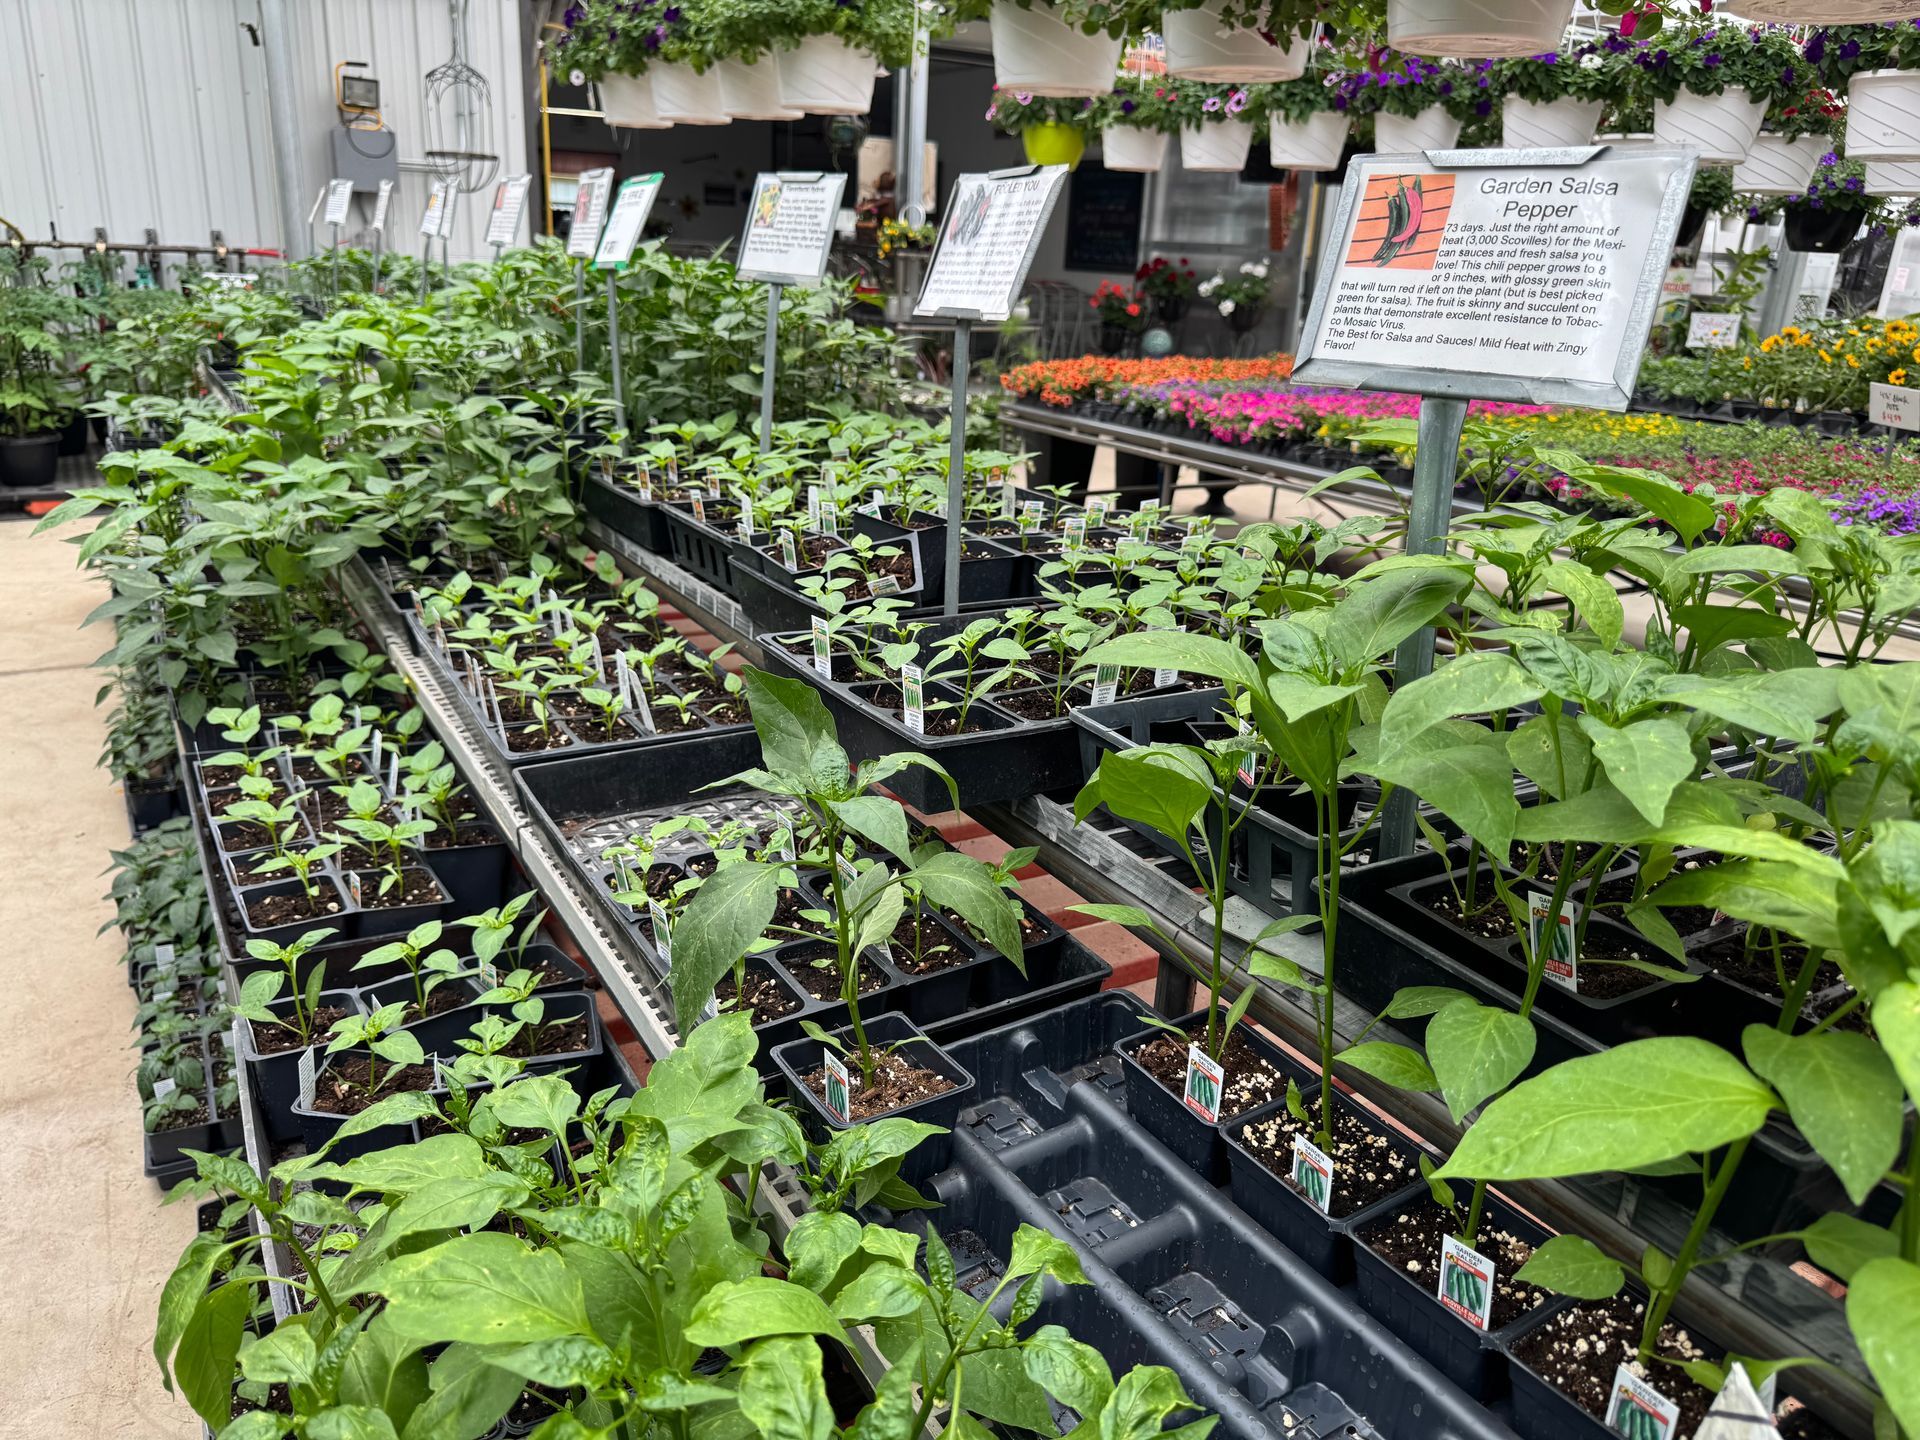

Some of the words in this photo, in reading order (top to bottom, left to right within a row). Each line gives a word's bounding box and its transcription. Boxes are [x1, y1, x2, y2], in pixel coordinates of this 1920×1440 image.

[1024, 180, 1040, 192] YOU
[1480, 177, 1552, 195] Garden
[1559, 177, 1619, 196] Salsa
[1503, 200, 1577, 221] Pepper
[1446, 223, 1459, 233] 73
[1460, 223, 1486, 234] days.
[1489, 223, 1511, 232] Just
[1514, 223, 1531, 233] the
[1533, 223, 1558, 236] right
[1561, 226, 1604, 236] amount
[1607, 226, 1620, 237] of
[1442, 236, 1464, 245] heat
[1465, 235, 1498, 246] (3,000
[1500, 235, 1552, 248] Scovilles)
[1555, 236, 1570, 246] for
[1573, 237, 1590, 247] the
[1593, 239, 1627, 250] Mexi-
[1497, 248, 1518, 258] and
[1519, 248, 1547, 259] fresh
[1549, 249, 1578, 260] salsa
[1581, 252, 1603, 262] you
[1434, 260, 1459, 270] love!
[1462, 260, 1481, 270] This
[1484, 261, 1505, 270] chili
[1507, 263, 1544, 272] pepper
[1547, 264, 1581, 274] grows
[1583, 263, 1595, 273] to
[1599, 265, 1607, 275] 8
[1431, 274, 1442, 282] or
[1444, 272, 1450, 282] 9
[1452, 273, 1487, 283] inches,
[1491, 274, 1512, 284] with
[1514, 275, 1549, 287] glossy
[1551, 277, 1583, 288] green
[1587, 278, 1611, 289] skin
[1340, 281, 1358, 290] that
[1360, 282, 1375, 291] will
[1377, 283, 1396, 293] turn
[1398, 284, 1415, 294] red
[1417, 284, 1425, 294] if
[1425, 285, 1440, 295] left
[1442, 286, 1454, 295] on
[1457, 286, 1473, 295] the
[1474, 286, 1501, 297] plant
[1503, 287, 1525, 299] (but
[1527, 288, 1536, 298] is
[1540, 289, 1563, 299] best
[1565, 291, 1603, 302] picked
[1336, 294, 1363, 303] green
[1366, 294, 1379, 303] for
[1381, 296, 1412, 307] salsa).
[1416, 296, 1433, 306] The
[1436, 297, 1455, 307] fruit
[1457, 298, 1465, 307] is
[1468, 298, 1501, 310] skinny
[1504, 301, 1524, 311] and
[1527, 302, 1578, 314] succulent
[1581, 305, 1596, 314] on
[1330, 317, 1341, 325] co
[1343, 317, 1377, 328] Mosaic
[1380, 319, 1406, 330] Virus.
[1333, 306, 1361, 315] plants
[1363, 306, 1382, 316] that
[1384, 307, 1443, 319] demonstrate
[1445, 311, 1491, 321] excellent
[1493, 313, 1548, 325] resistance
[1552, 315, 1562, 326] to
[1566, 316, 1603, 328] Tobac-
[1323, 340, 1355, 351] Flavor!
[1328, 328, 1344, 338] The
[1347, 329, 1368, 339] Best
[1370, 330, 1384, 339] for
[1385, 332, 1413, 343] Salsa
[1415, 334, 1433, 344] and
[1435, 335, 1477, 347] Sauces!
[1479, 337, 1501, 348] Mild
[1504, 339, 1530, 351] Heat
[1533, 342, 1554, 352] with
[1556, 342, 1588, 356] Zingy
[1544, 971, 1566, 983] PEPPER
[1468, 1310, 1482, 1324] HEAT
